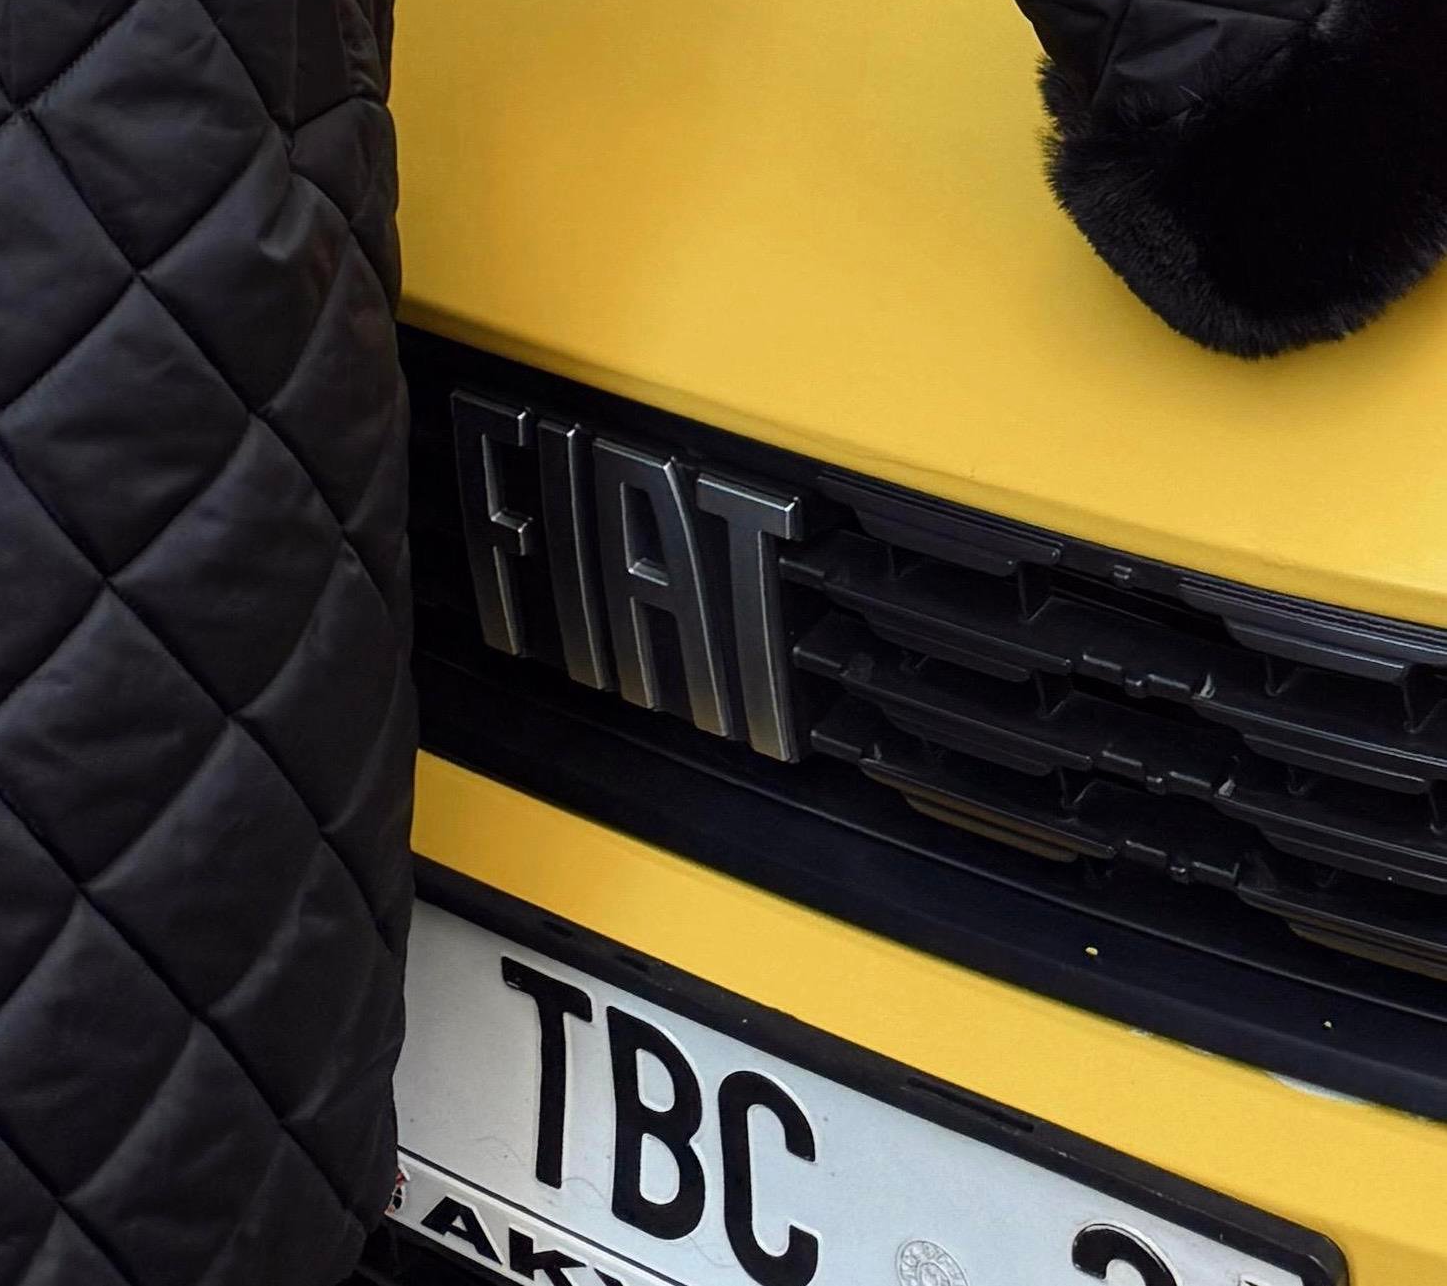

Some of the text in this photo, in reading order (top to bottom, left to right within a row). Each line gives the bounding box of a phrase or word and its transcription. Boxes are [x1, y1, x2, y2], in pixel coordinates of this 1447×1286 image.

[451, 389, 804, 763] FIAT
[421, 1195, 625, 1286] AK
[500, 955, 821, 1286] TBC
